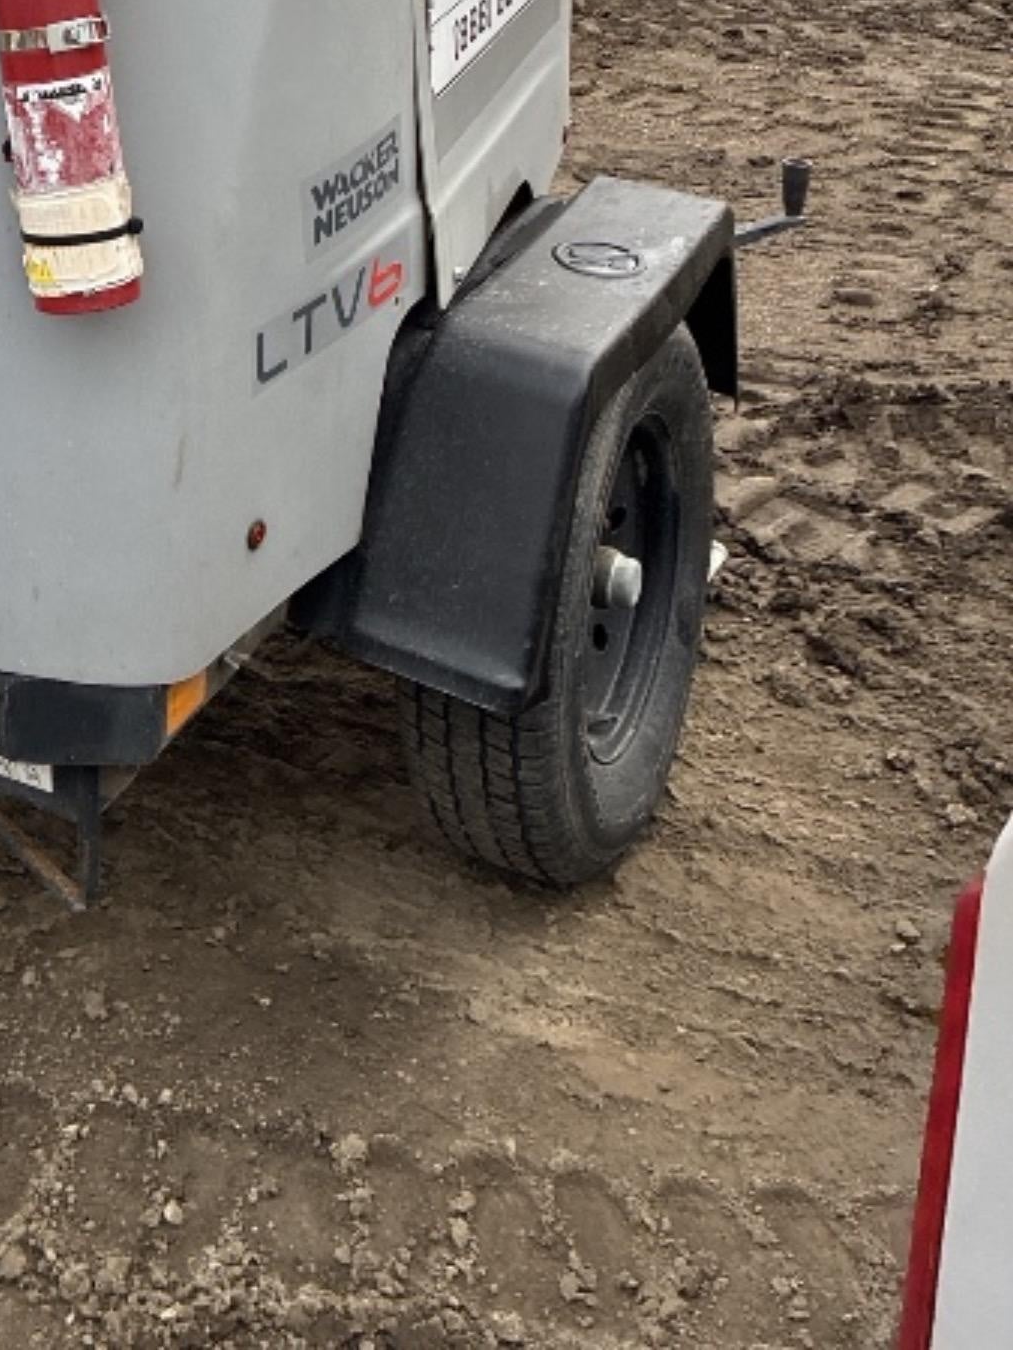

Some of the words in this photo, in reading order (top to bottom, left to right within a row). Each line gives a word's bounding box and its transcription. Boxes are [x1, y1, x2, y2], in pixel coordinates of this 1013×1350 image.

[310, 131, 399, 211] WACKER
[313, 157, 400, 247] NEUSON
[256, 255, 402, 384] LTV6
